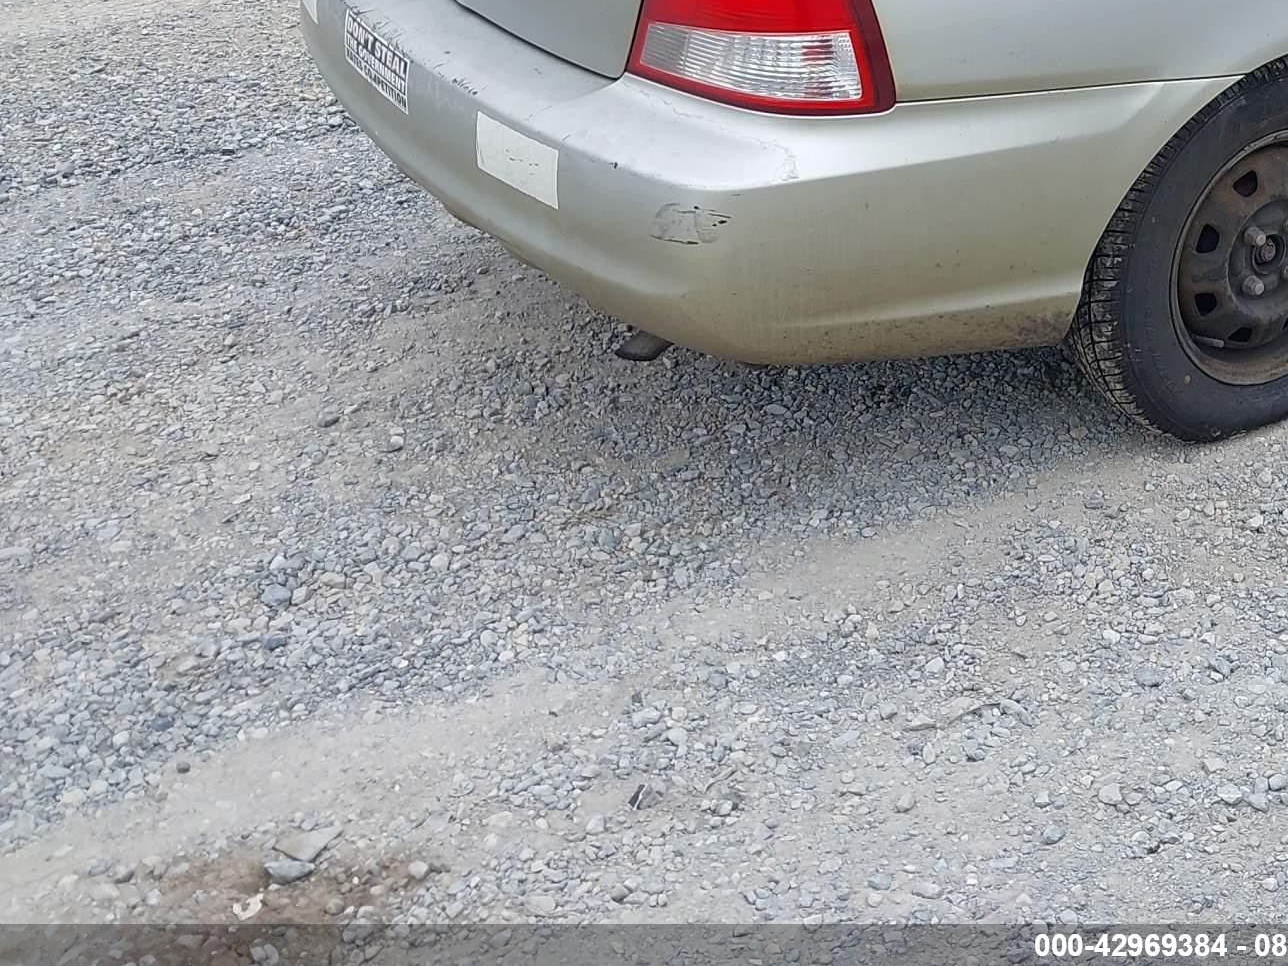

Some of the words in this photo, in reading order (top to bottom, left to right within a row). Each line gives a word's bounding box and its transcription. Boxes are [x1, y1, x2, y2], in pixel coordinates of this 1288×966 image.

[346, 32, 358, 53] THE
[358, 44, 406, 94] GOVERNMENT
[347, 15, 374, 52] DON'T
[374, 41, 406, 79] STEAL
